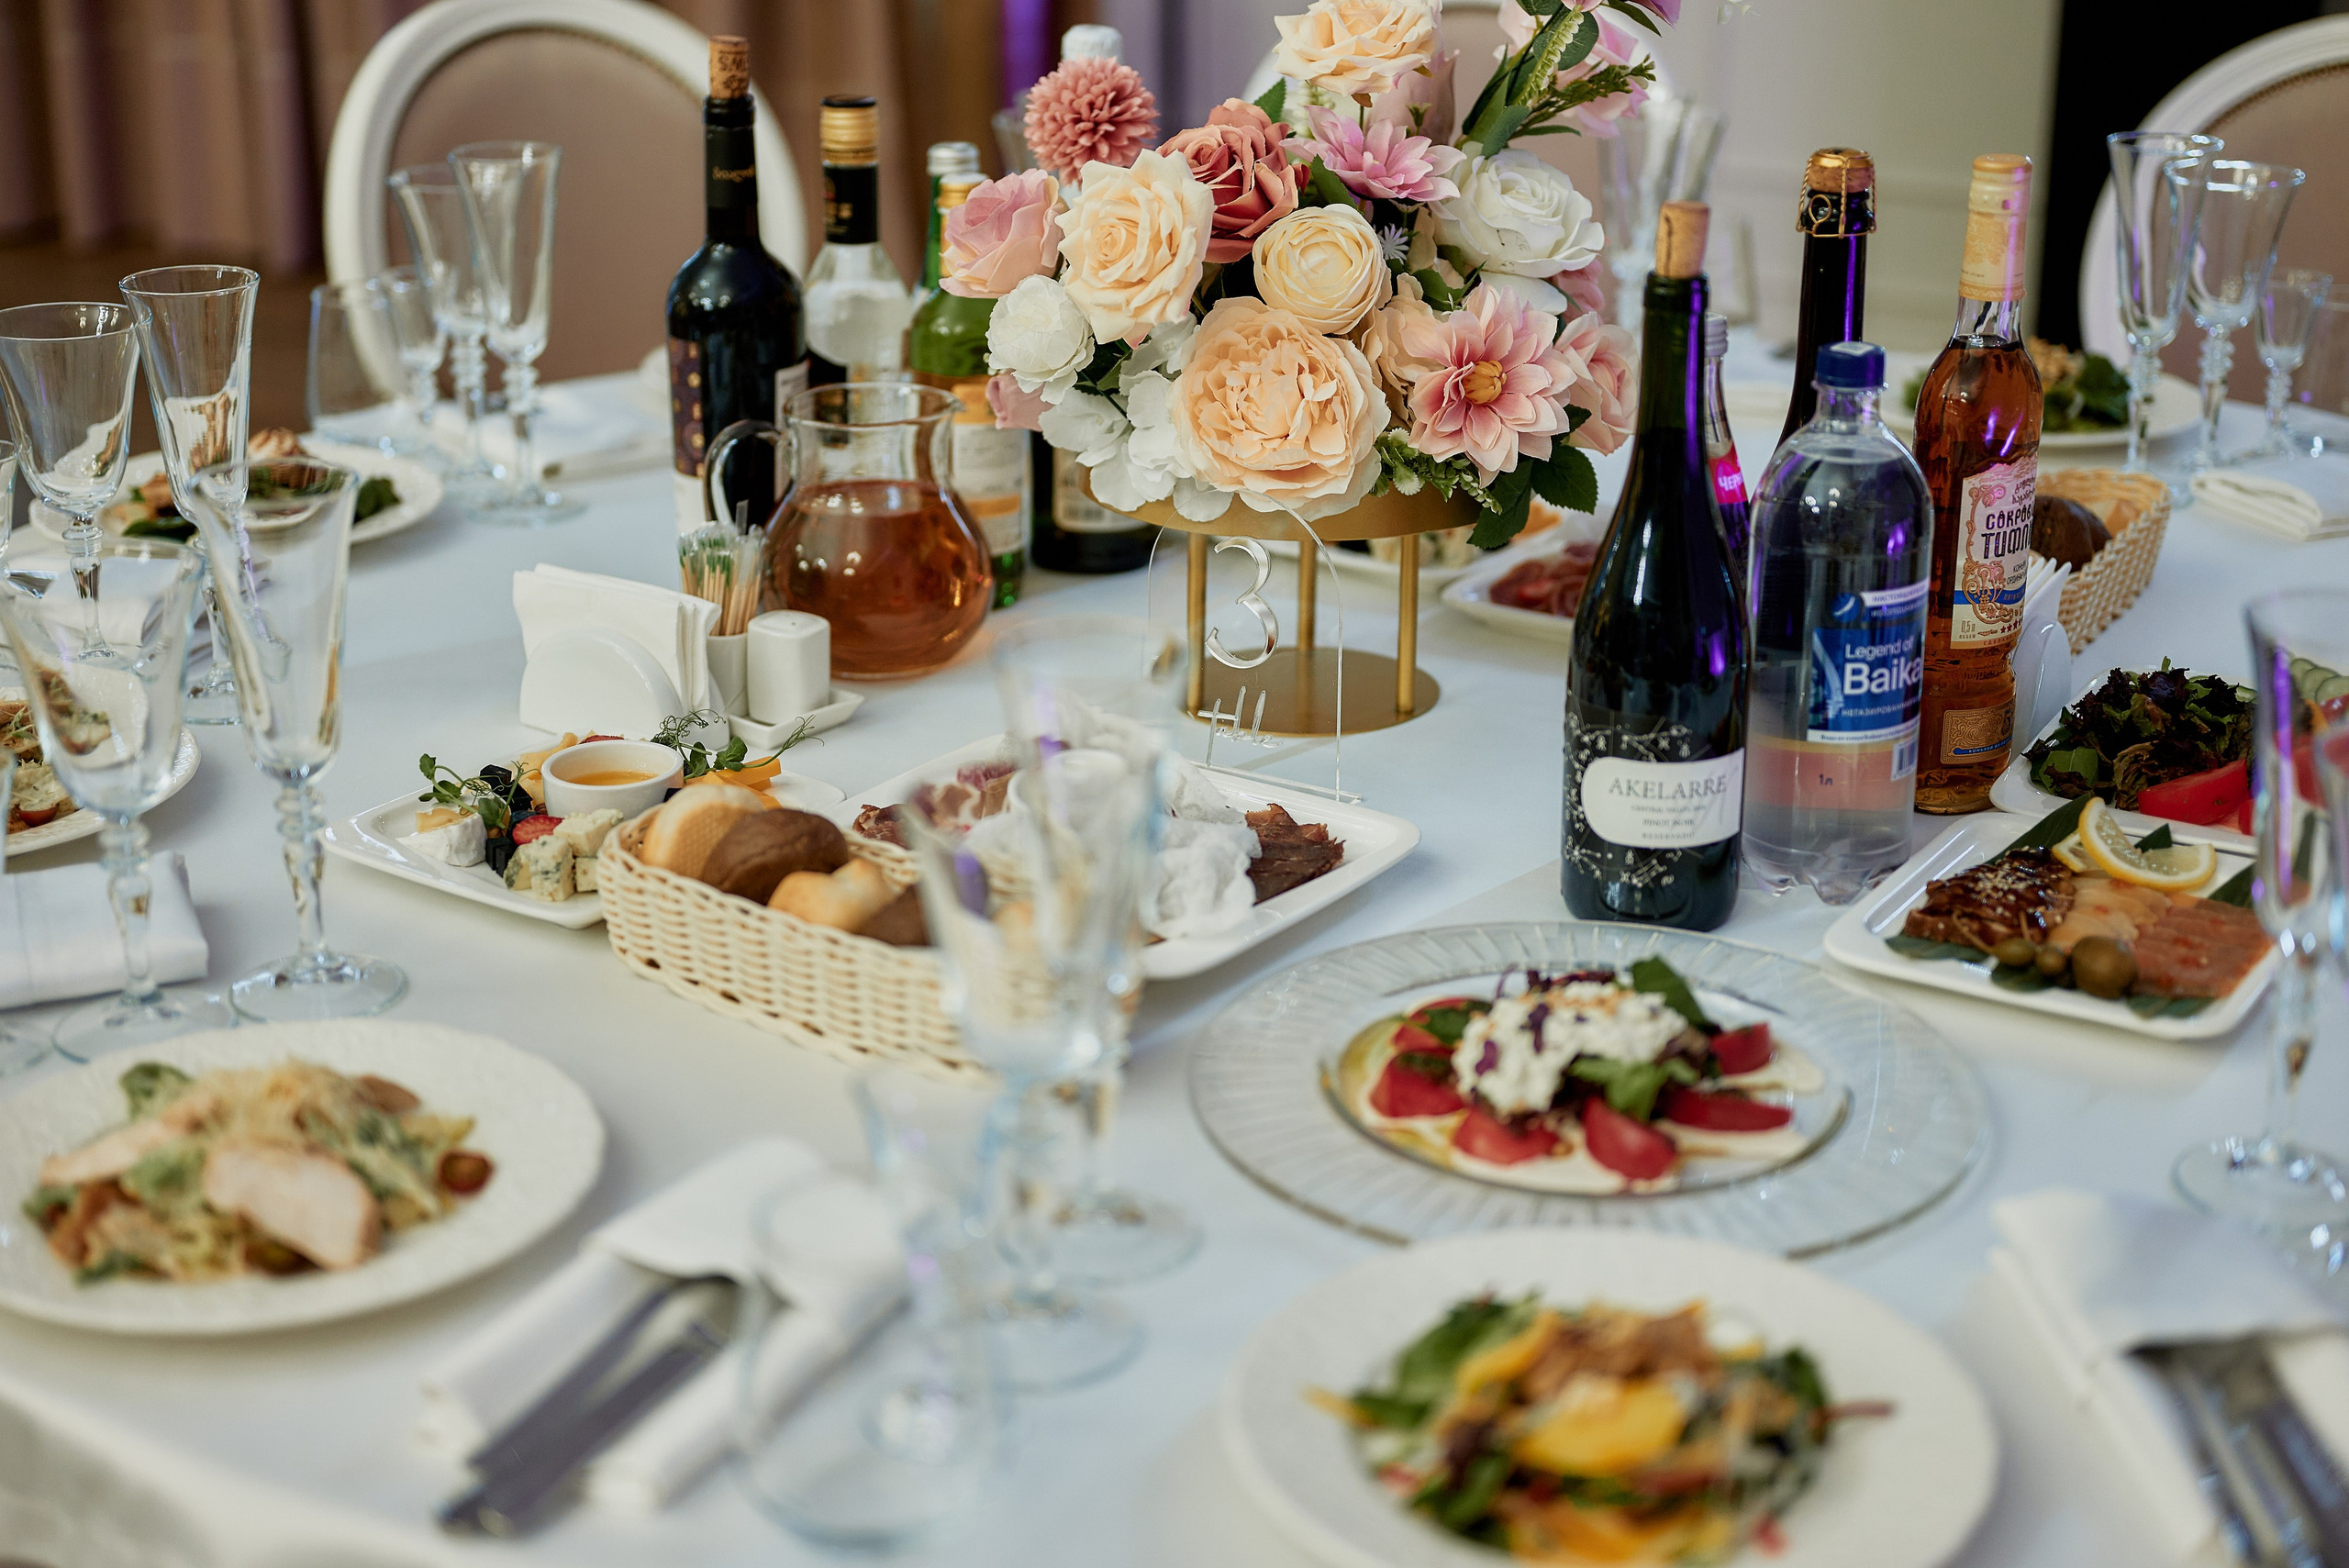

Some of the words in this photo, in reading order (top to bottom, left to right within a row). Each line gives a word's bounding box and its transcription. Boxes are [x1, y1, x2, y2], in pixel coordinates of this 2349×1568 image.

[1205, 536, 1279, 669] 3
[1845, 639, 1902, 661] Legend
[1902, 634, 1914, 651] of
[1842, 656, 1921, 695] Baika
[1609, 774, 1728, 799] AKELARRE
